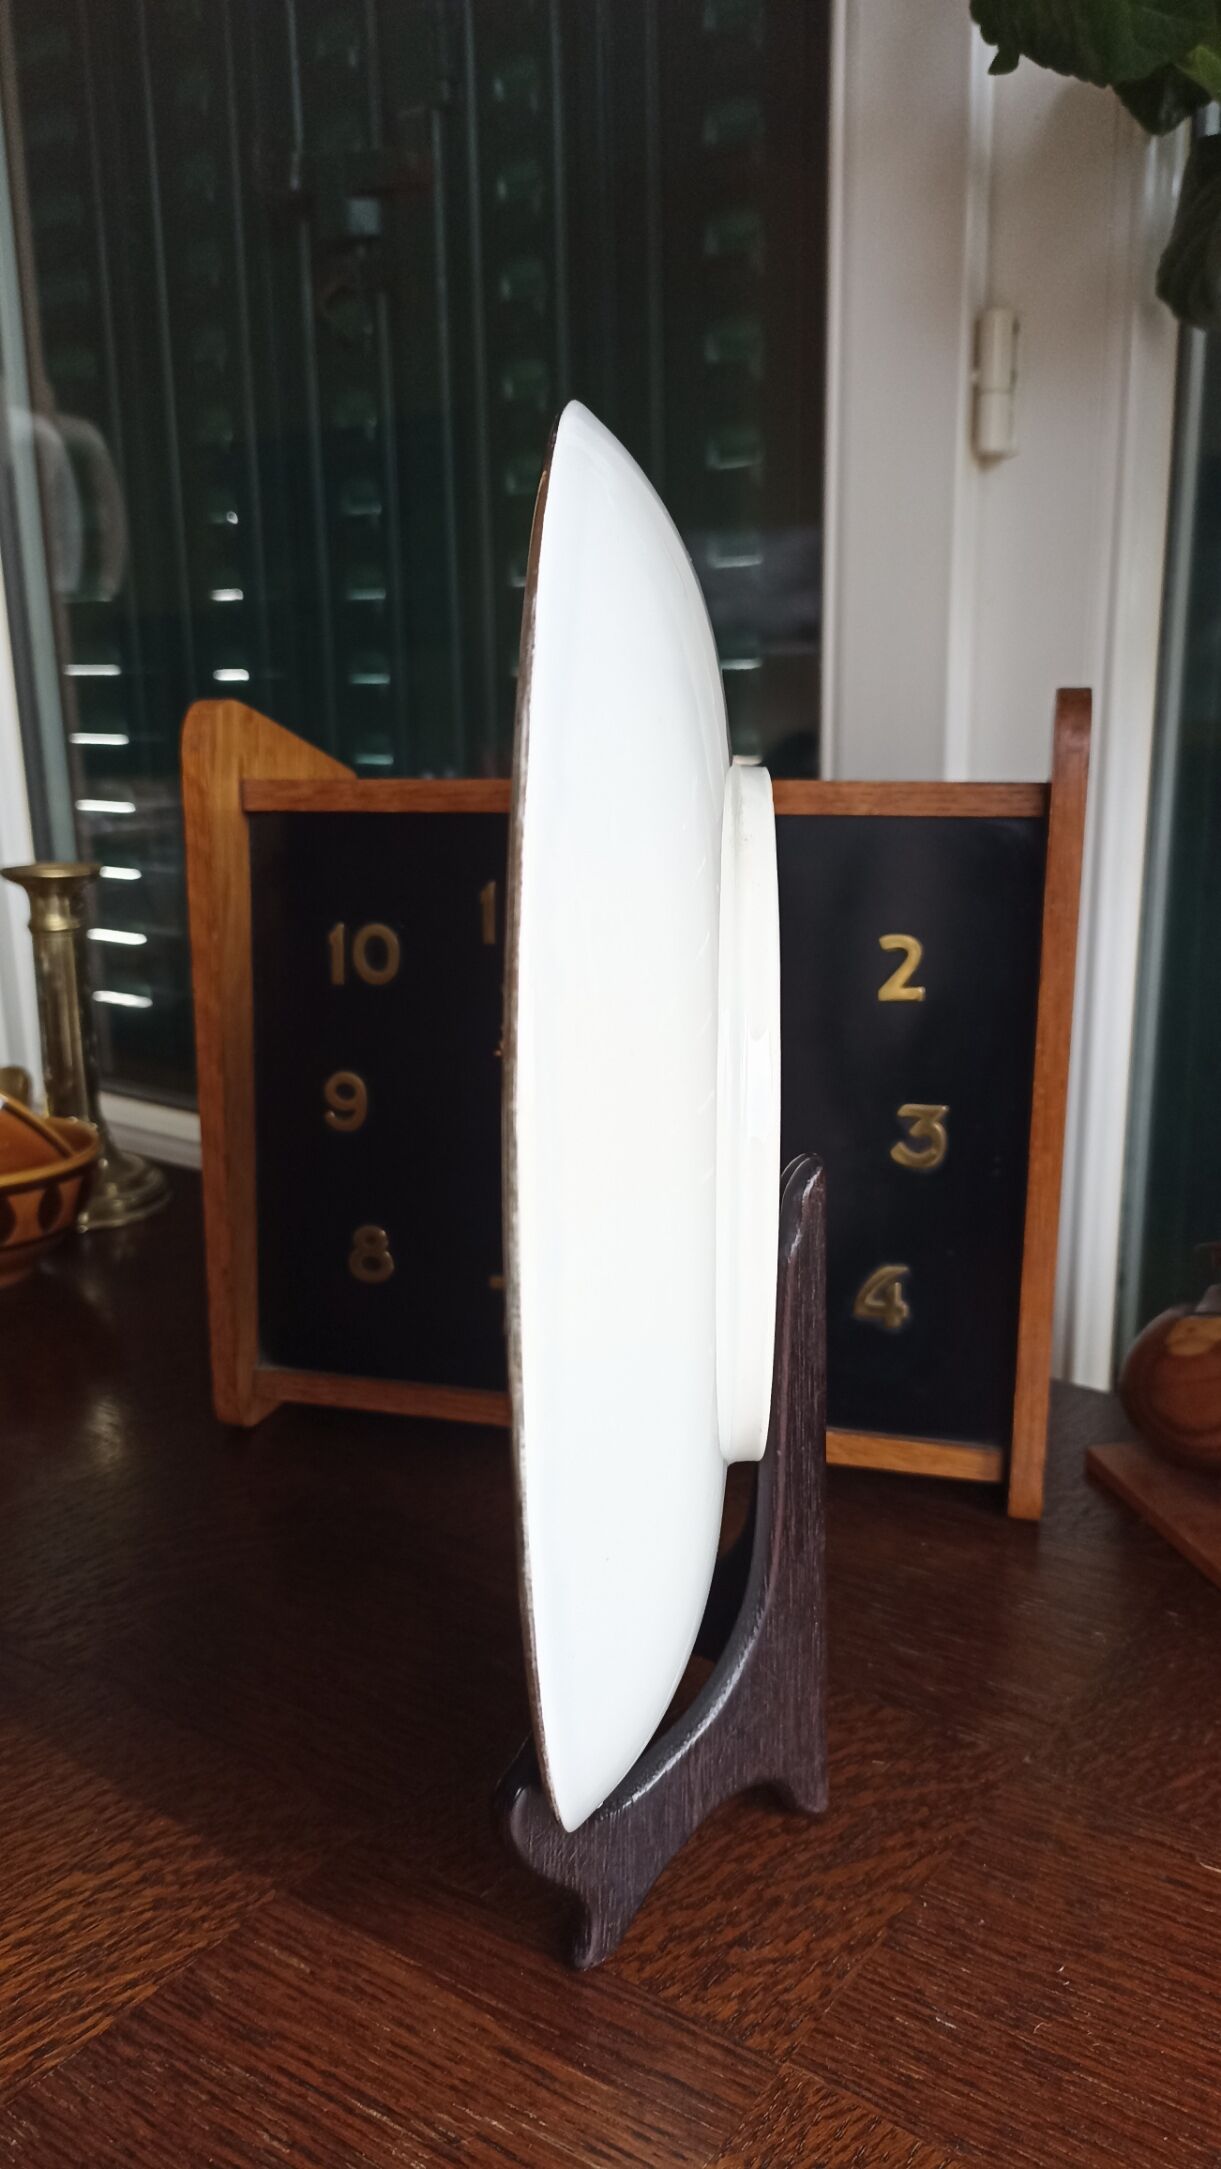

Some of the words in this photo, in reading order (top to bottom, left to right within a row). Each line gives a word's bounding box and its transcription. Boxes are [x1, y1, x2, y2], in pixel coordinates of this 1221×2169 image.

[479, 881, 497, 945] 1
[327, 921, 401, 986] 10
[878, 933, 925, 1001] 2
[323, 1070, 368, 1132] 9
[891, 1103, 949, 1169] 3
[348, 1225, 395, 1284] 8
[853, 1264, 912, 1329] 4
